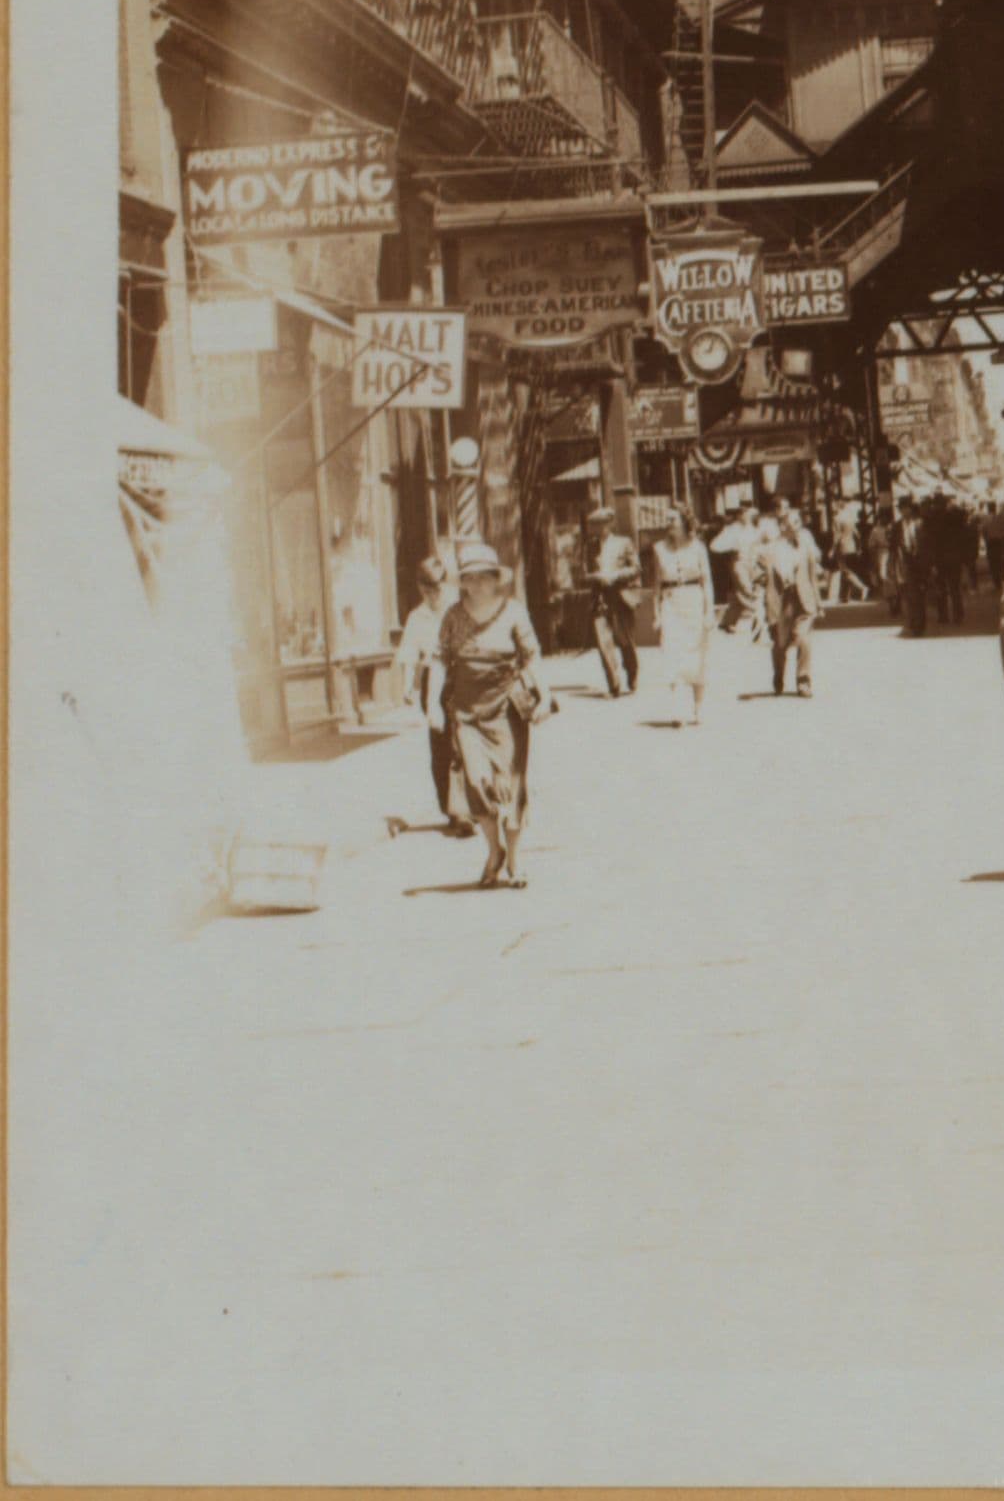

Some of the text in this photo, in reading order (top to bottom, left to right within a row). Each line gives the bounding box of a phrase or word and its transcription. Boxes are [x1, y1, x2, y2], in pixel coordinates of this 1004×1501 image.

[188, 163, 395, 213] MOVING
[311, 202, 395, 228] DISTANCE
[486, 274, 622, 297] CHOP SUEY
[656, 253, 756, 291] WILLOW
[515, 316, 586, 336] FOOD
[658, 287, 760, 336] CAFETERIA
[370, 319, 454, 352] MALT
[361, 361, 454, 397] HOPS
